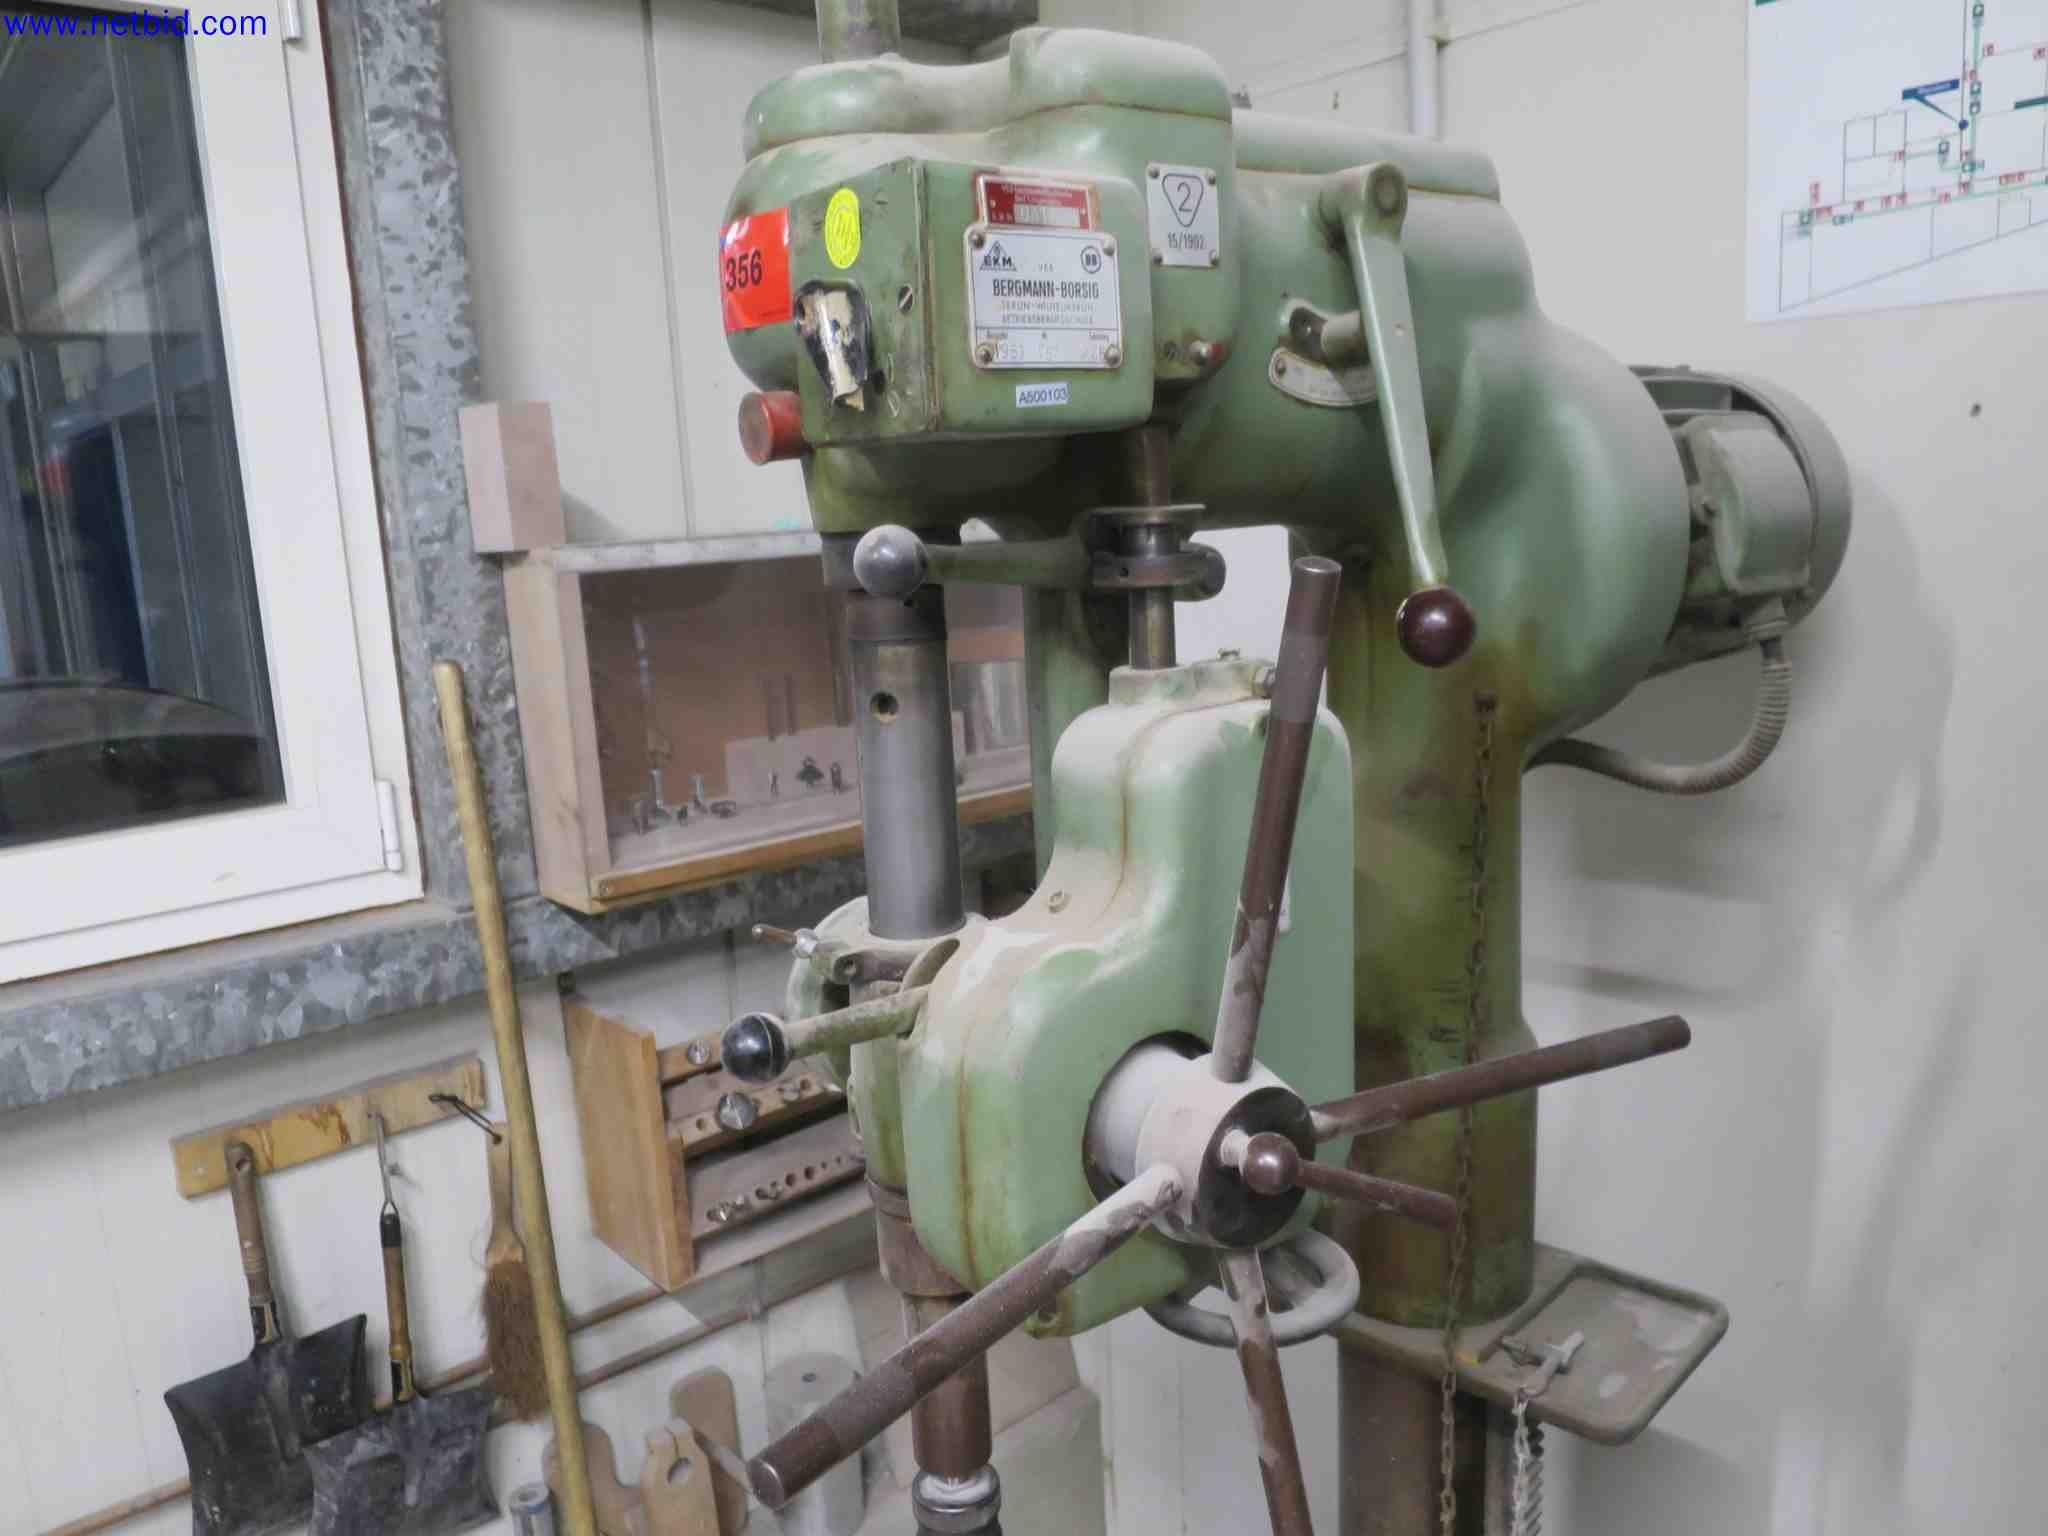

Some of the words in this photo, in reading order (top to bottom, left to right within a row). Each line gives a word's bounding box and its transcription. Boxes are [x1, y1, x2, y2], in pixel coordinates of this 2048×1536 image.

[1177, 182, 1193, 212] 2
[725, 249, 763, 291] 356
[993, 279, 1099, 299] BERGMANN-BORSIG
